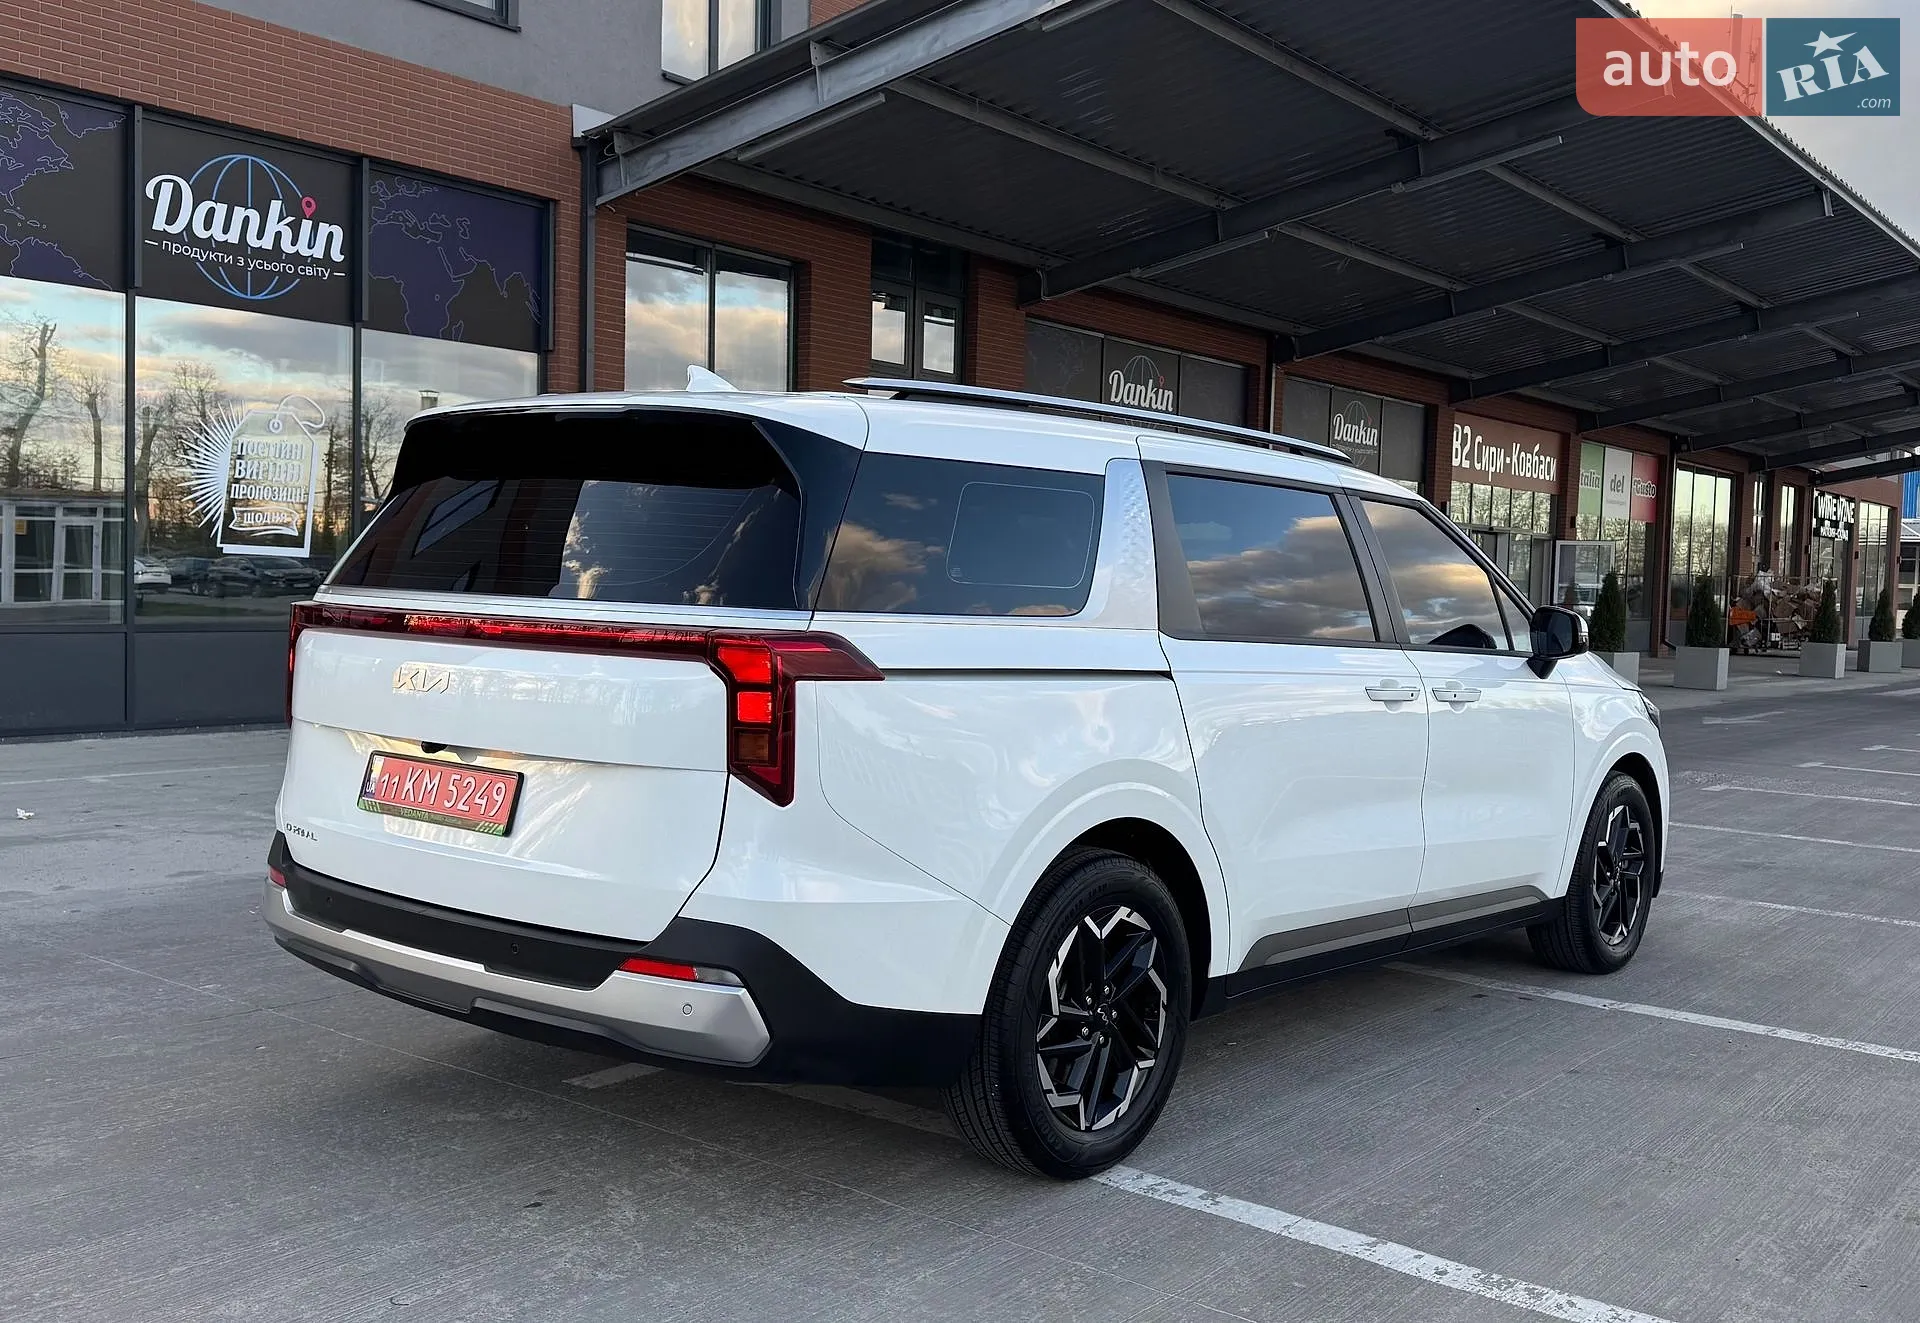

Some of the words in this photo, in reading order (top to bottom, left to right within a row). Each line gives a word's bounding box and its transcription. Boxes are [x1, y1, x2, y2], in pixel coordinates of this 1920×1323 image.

[145, 174, 345, 263] Dankin
[162, 240, 233, 265] продукти
[236, 256, 245, 266] з
[247, 258, 294, 275] усього
[297, 264, 331, 280] світу
[1109, 369, 1174, 412] Dankin
[1333, 413, 1378, 447] Dankin
[1609, 474, 1625, 493] del
[243, 511, 288, 525] ЩОДНЯ
[393, 664, 451, 695] KIA
[380, 772, 400, 799] 11
[444, 773, 507, 818] 5249
